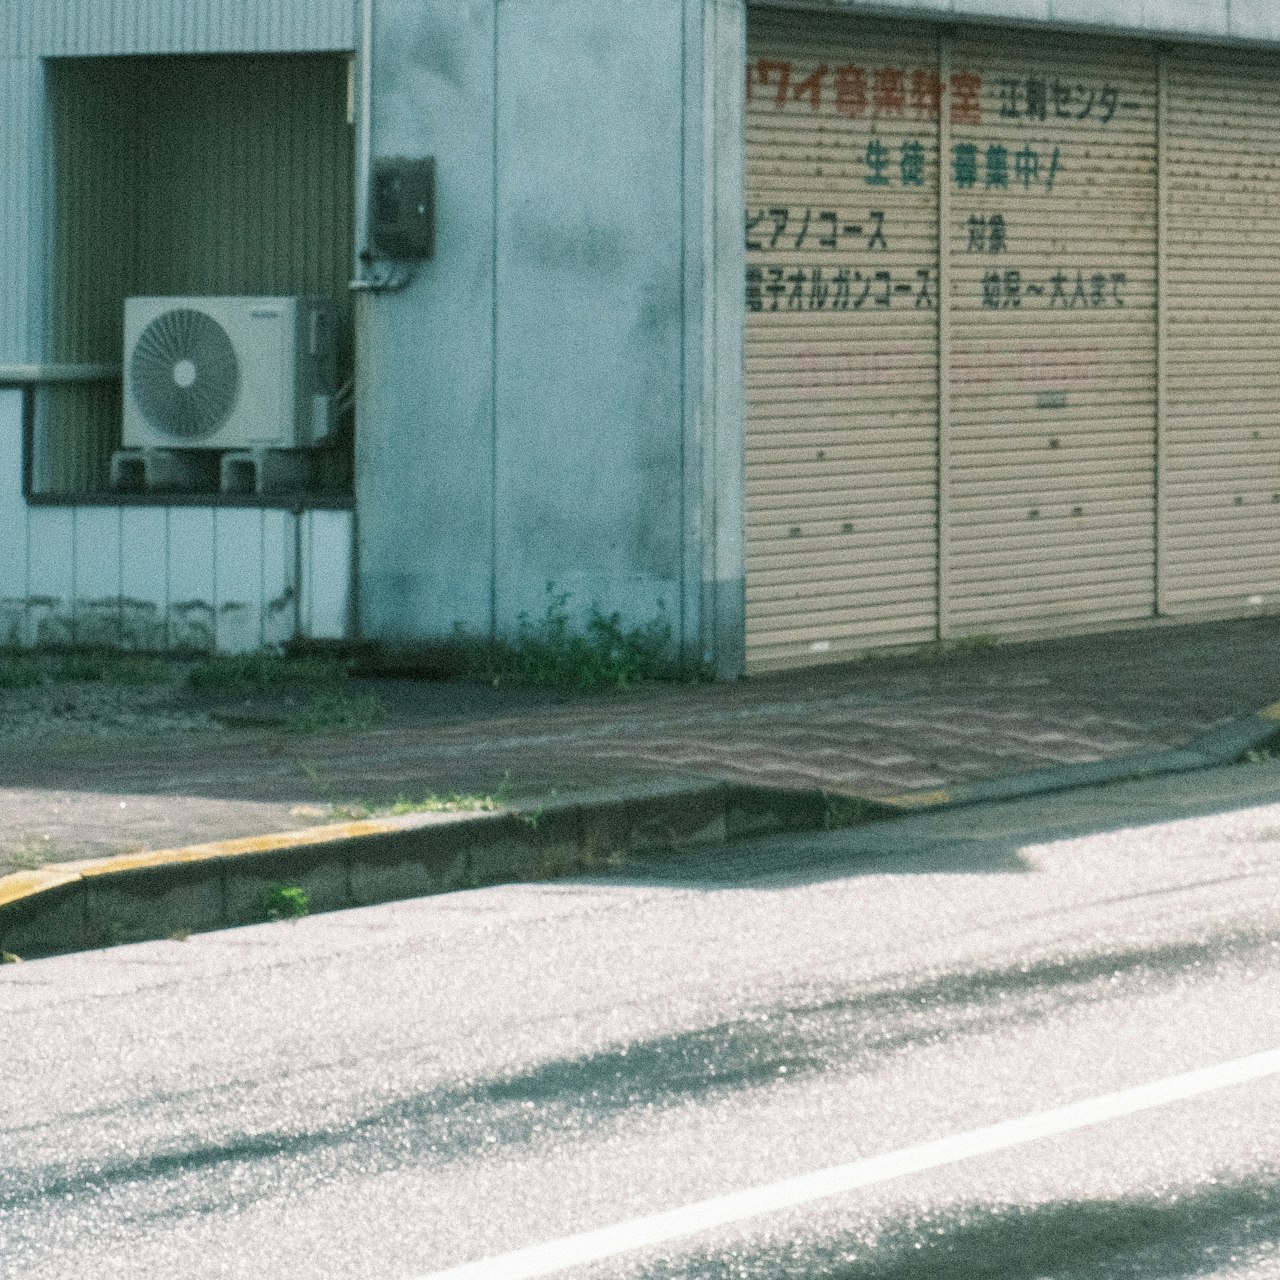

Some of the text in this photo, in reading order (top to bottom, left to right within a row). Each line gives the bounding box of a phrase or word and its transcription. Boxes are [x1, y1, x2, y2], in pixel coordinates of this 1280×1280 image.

[747, 59, 983, 124] ワイ音楽教室
